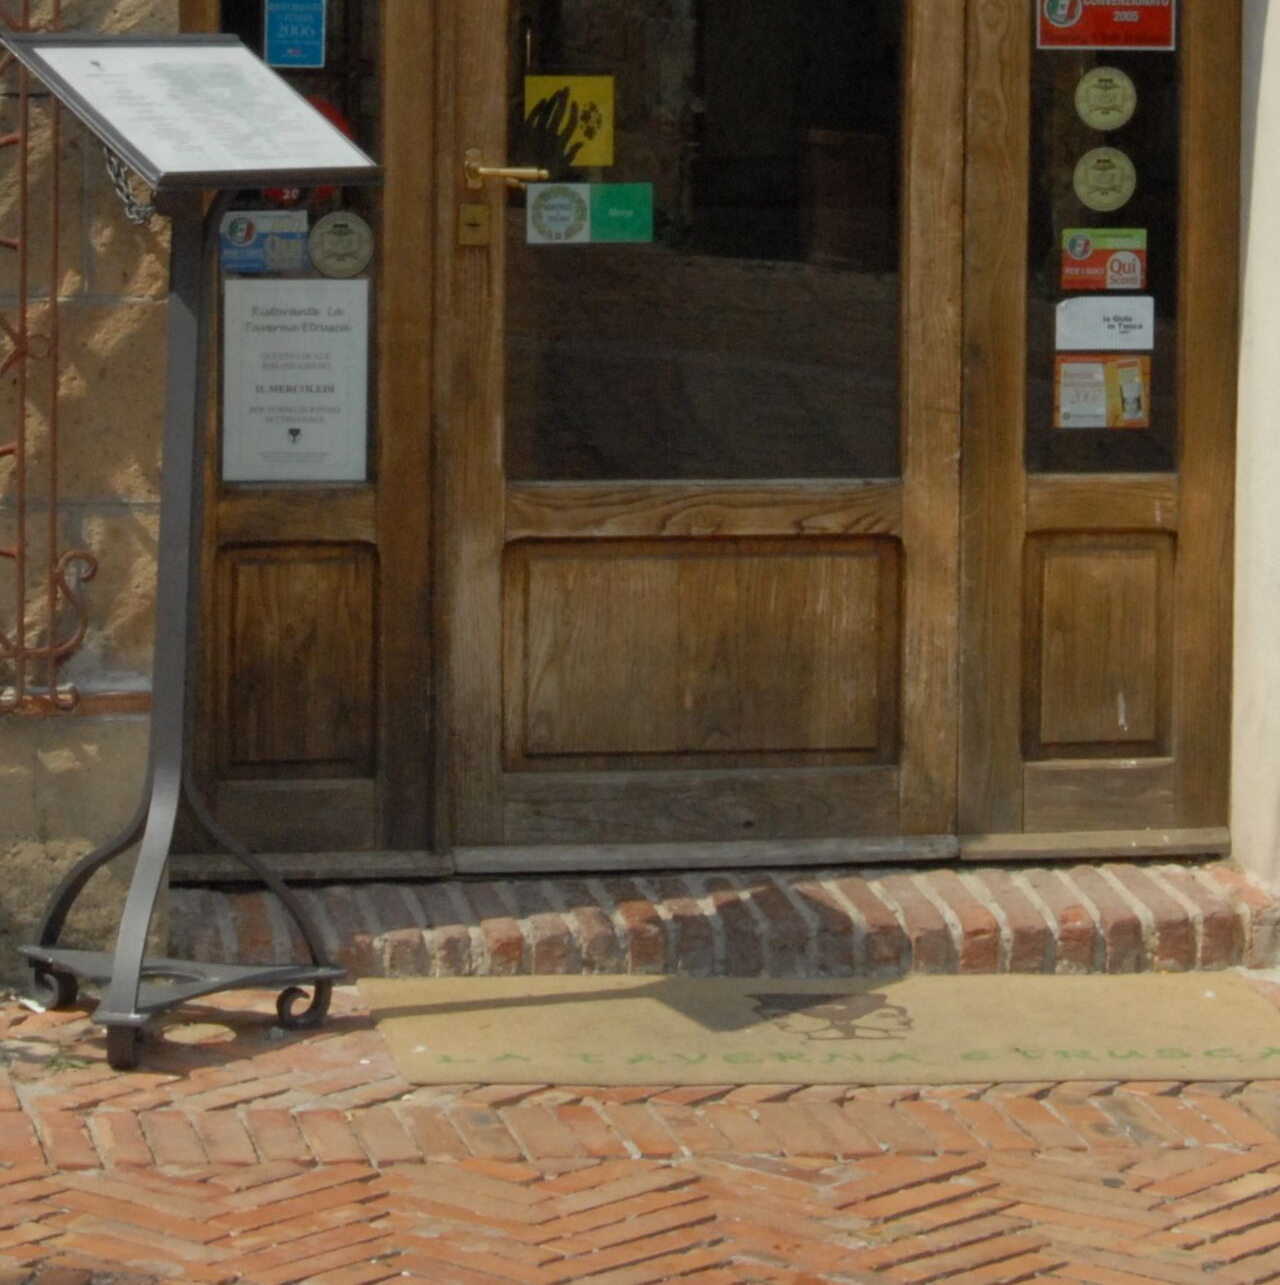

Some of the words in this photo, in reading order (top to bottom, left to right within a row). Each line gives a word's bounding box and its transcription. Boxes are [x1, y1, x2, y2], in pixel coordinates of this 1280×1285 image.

[1110, 257, 1136, 276] Qui
[251, 306, 321, 316] Ristorante
[244, 321, 301, 332] Taverna
[301, 321, 352, 332] Etrusca
